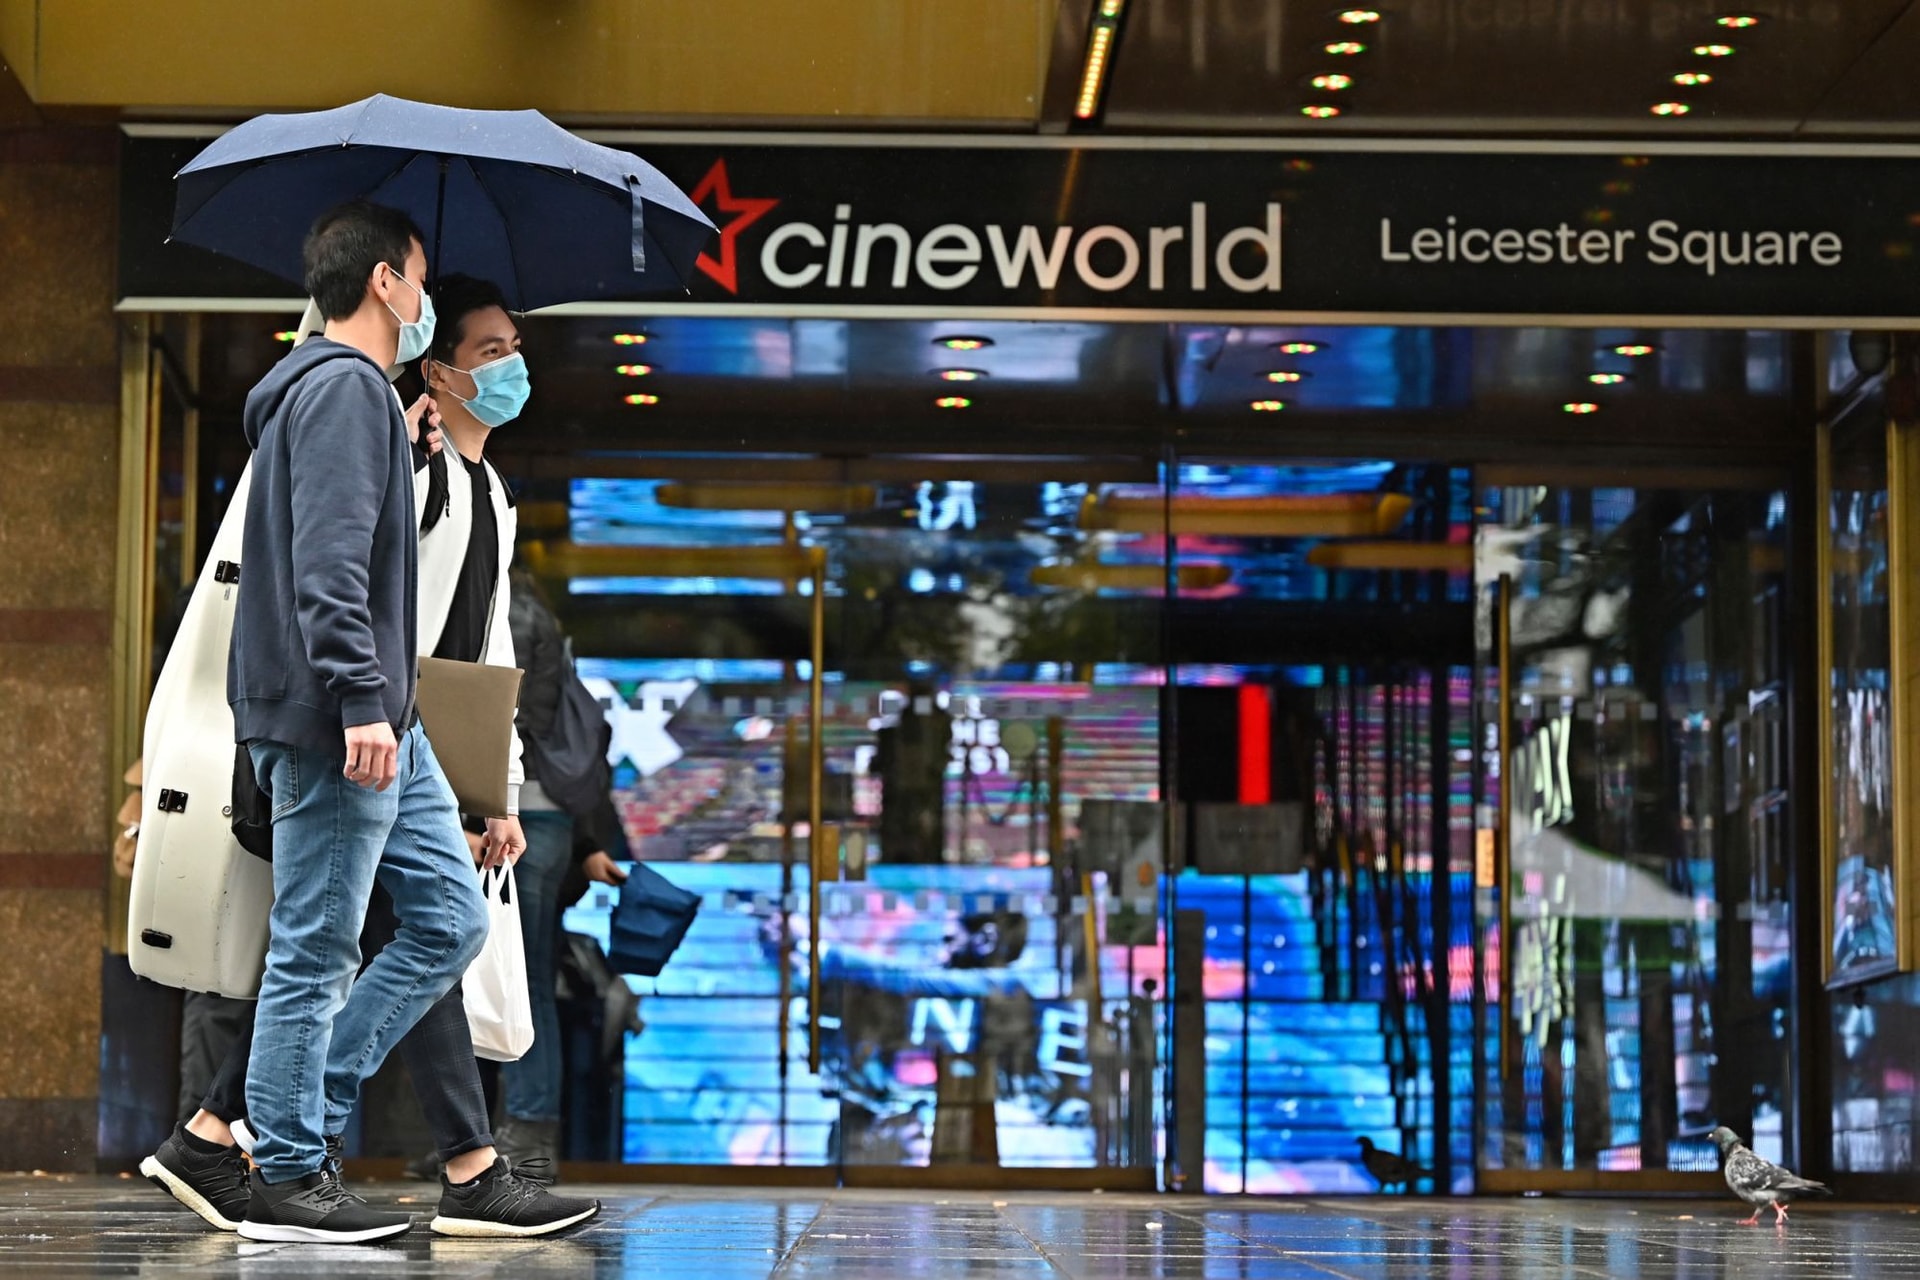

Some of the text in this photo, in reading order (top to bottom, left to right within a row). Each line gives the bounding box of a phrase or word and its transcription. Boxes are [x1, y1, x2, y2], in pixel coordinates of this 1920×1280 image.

[760, 201, 1282, 292] cineworld
[1380, 215, 1843, 276] Leicester Square
